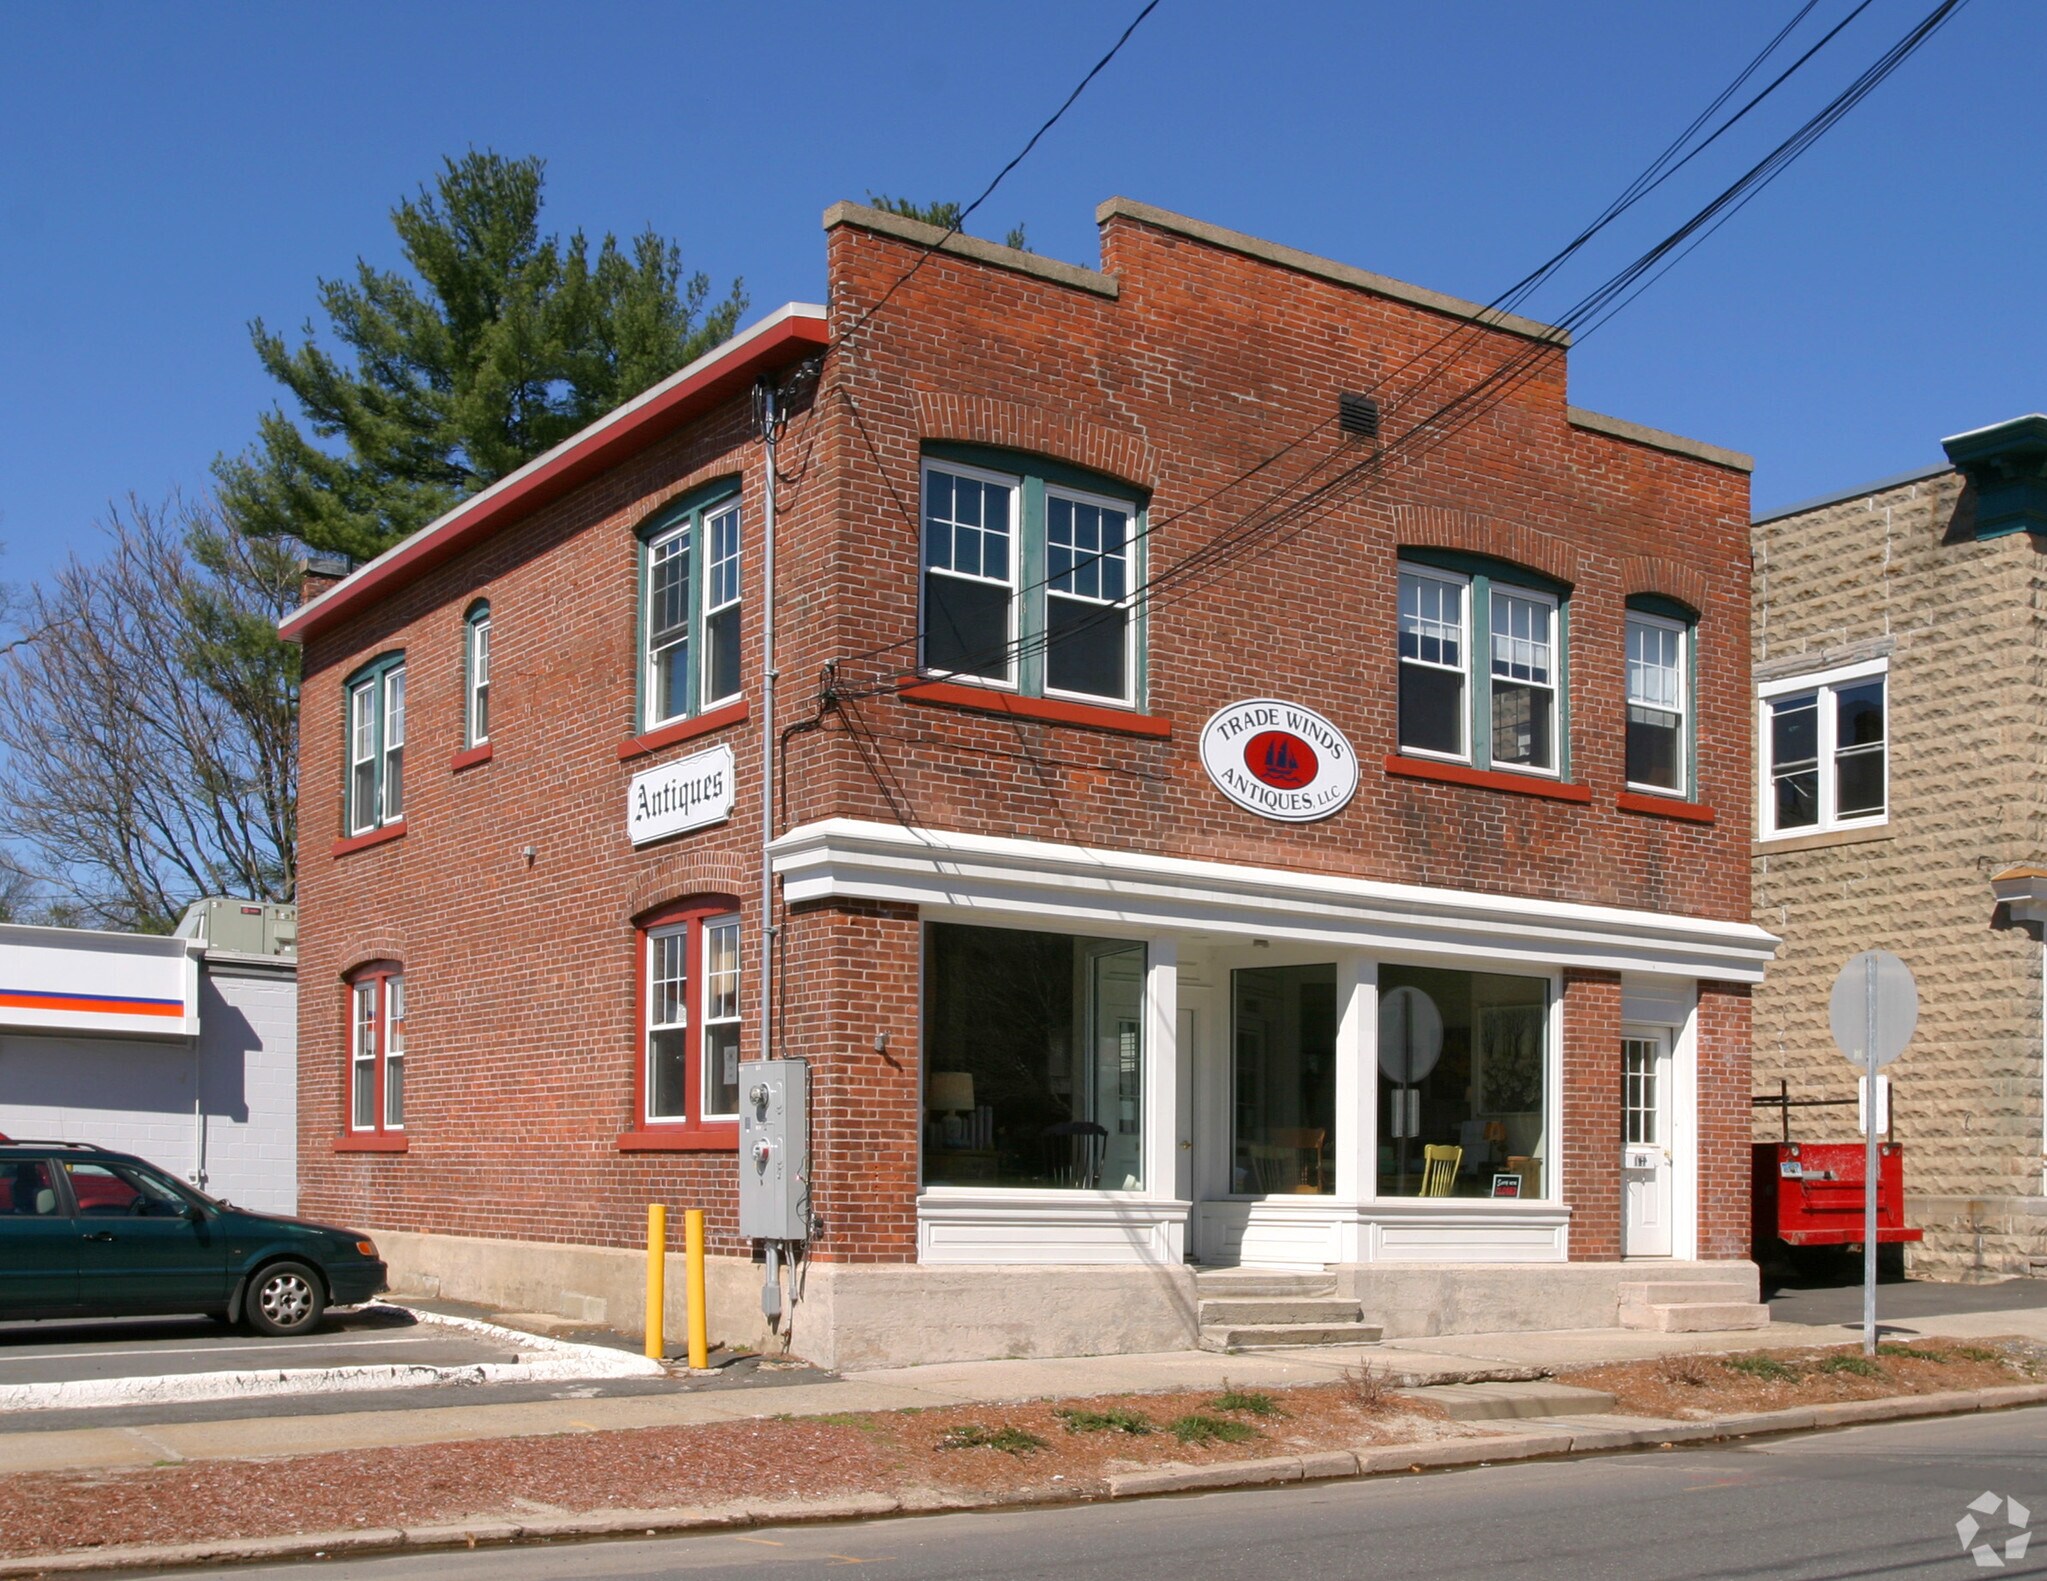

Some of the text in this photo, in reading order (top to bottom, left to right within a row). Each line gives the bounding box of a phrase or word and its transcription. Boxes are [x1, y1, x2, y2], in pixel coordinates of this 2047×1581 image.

[1216, 708, 1344, 760] TRADE WINDS
[635, 769, 723, 822] Antiques
[1221, 767, 1341, 811] ANTIQUES, LLC
